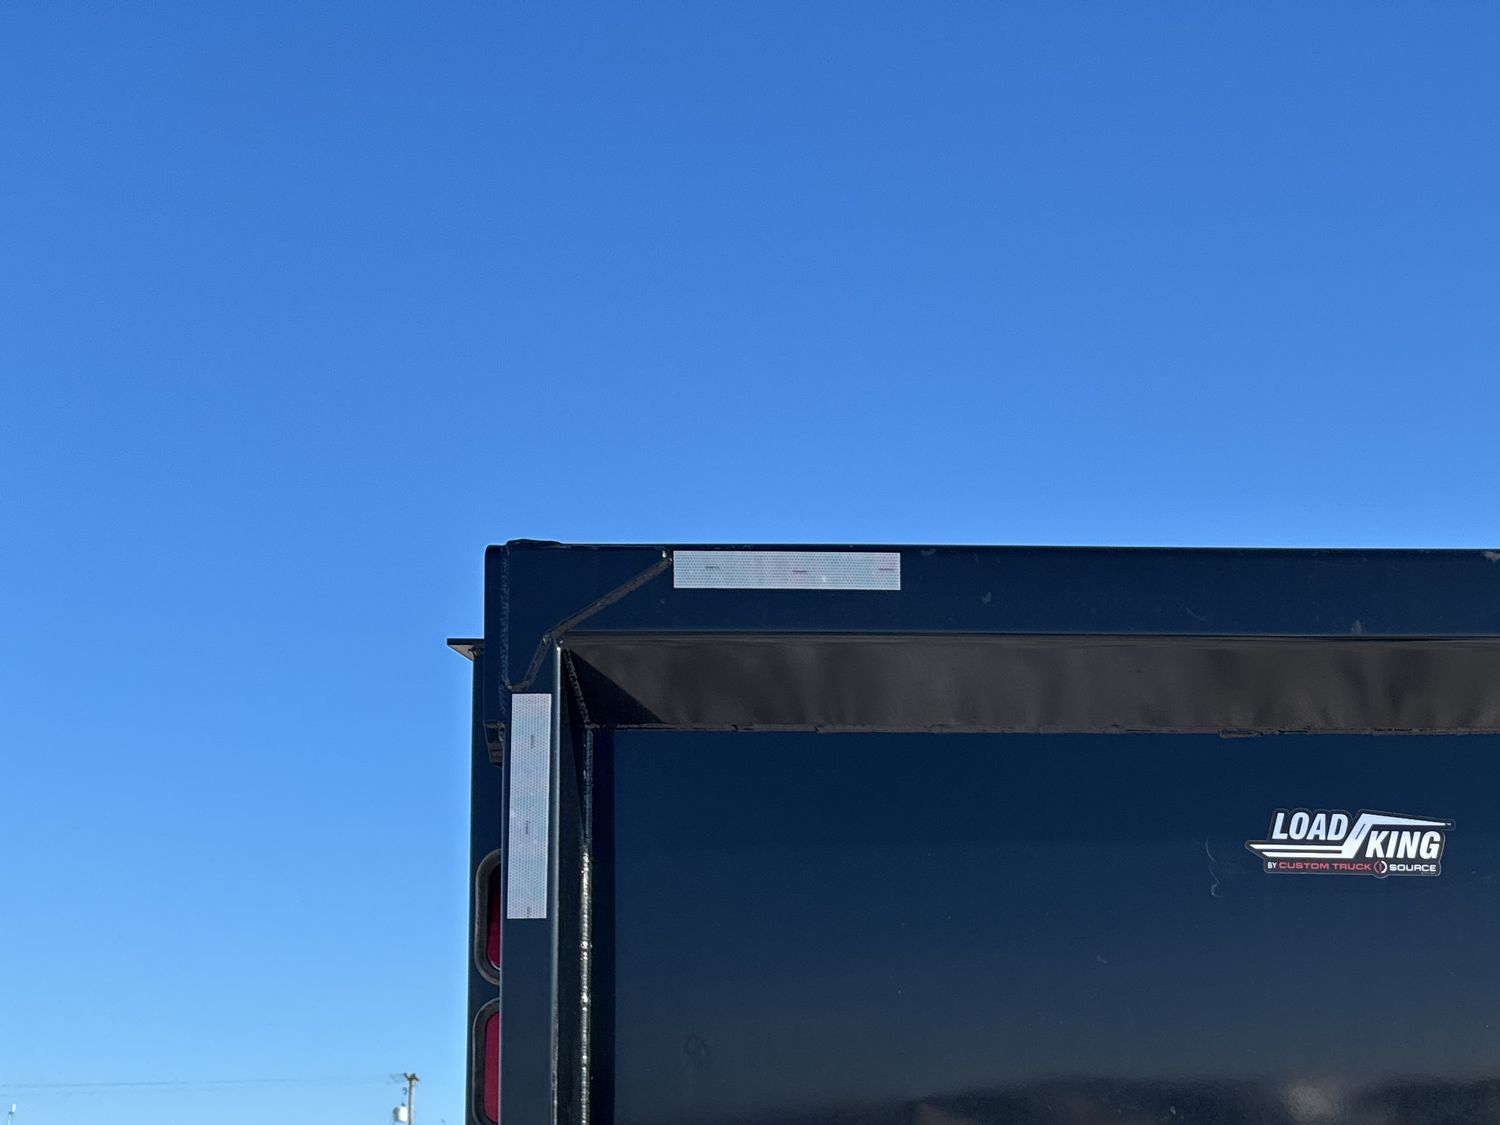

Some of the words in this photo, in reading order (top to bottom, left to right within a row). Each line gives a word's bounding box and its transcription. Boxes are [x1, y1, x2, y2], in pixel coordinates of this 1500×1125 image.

[1271, 811, 1349, 841] LOAD
[1365, 830, 1441, 859] KING
[1267, 861, 1277, 869] BY
[1278, 861, 1330, 870] CUSTOM
[1331, 862, 1372, 871] TRUCK
[1389, 863, 1437, 872] SOURCE
